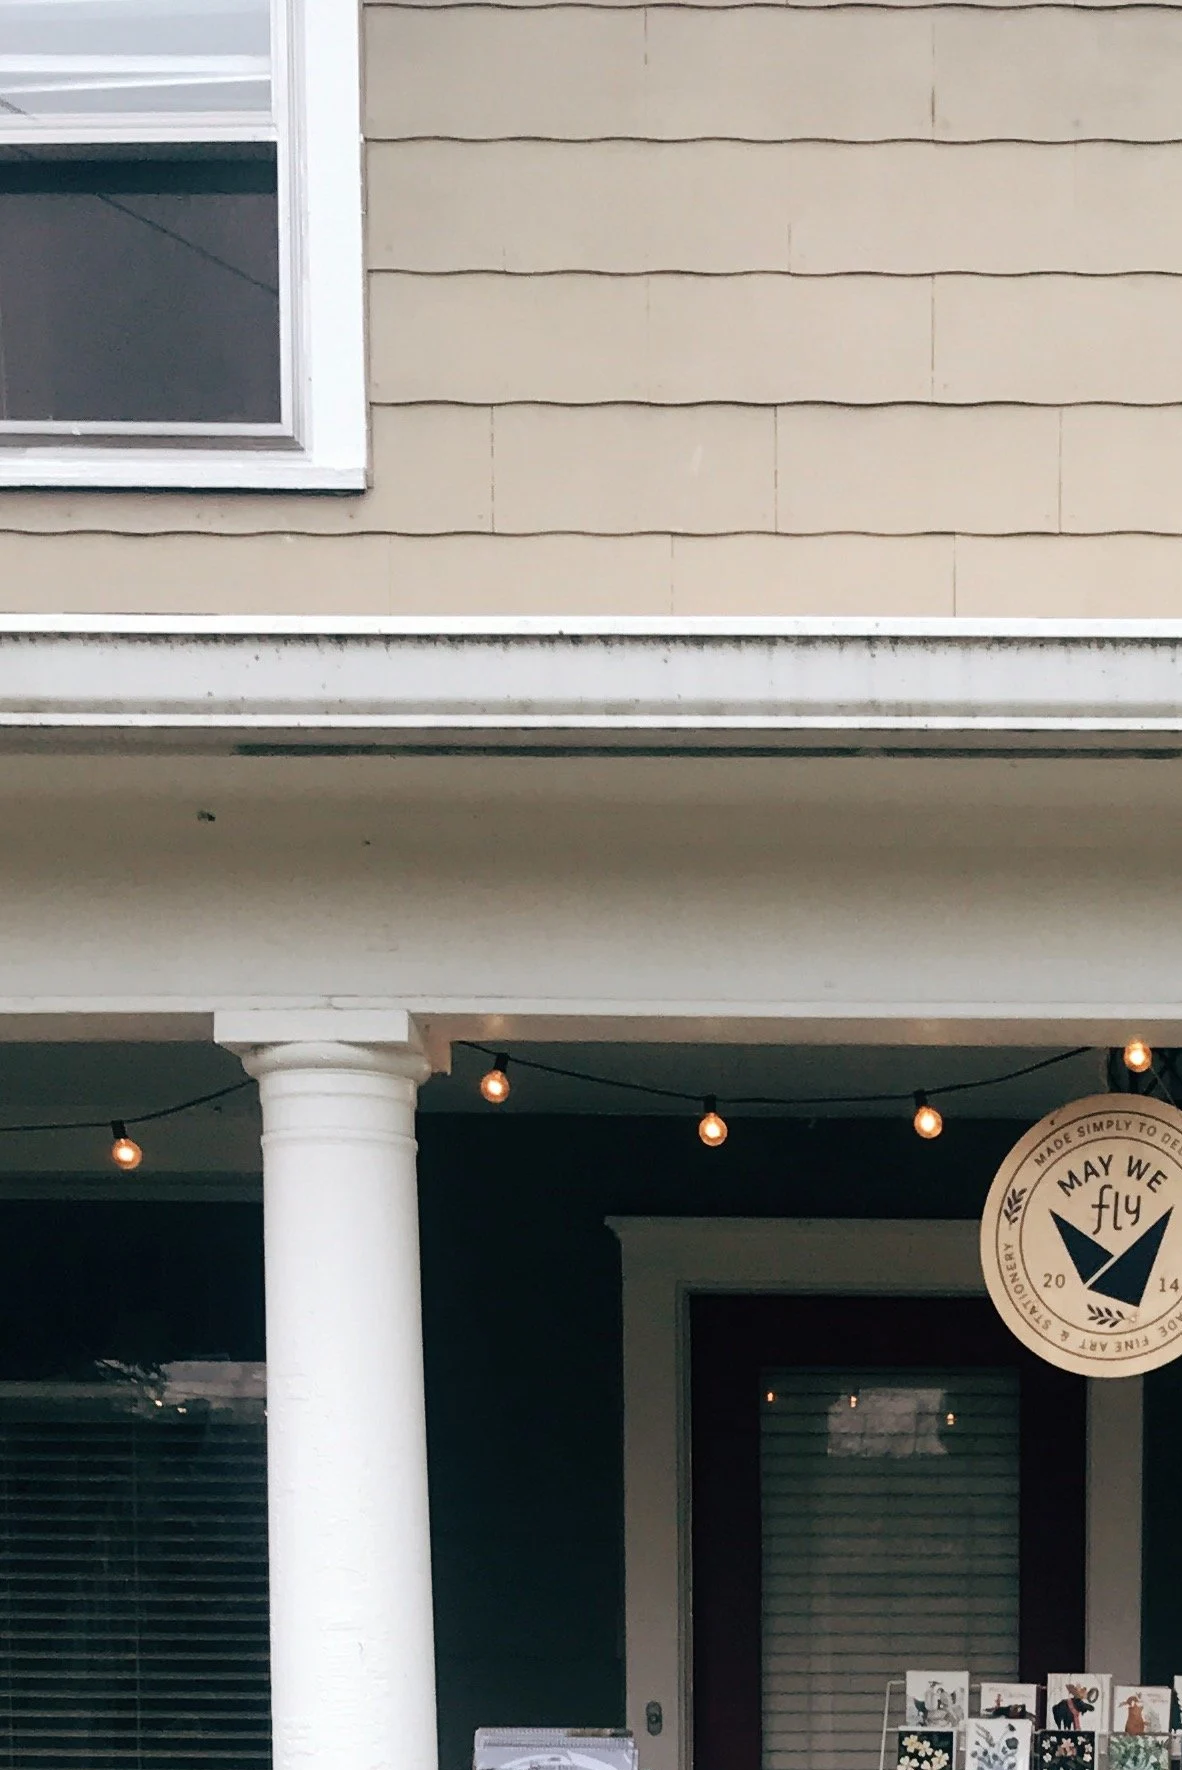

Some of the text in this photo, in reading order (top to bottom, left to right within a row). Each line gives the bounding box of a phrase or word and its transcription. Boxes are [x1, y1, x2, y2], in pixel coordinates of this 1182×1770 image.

[1033, 1132, 1072, 1167] MADE
[1076, 1119, 1133, 1139] SIMPLY
[1138, 1121, 1158, 1138] TO
[1056, 1153, 1169, 1198] MAY WE
[1090, 1183, 1142, 1236] fly
[1003, 1242, 1053, 1331] STATIONERY
[1042, 1272, 1180, 1293] 20 14
[1059, 1329, 1071, 1342] &
[1078, 1340, 1109, 1352] ART
[1114, 1334, 1150, 1353] FINE
